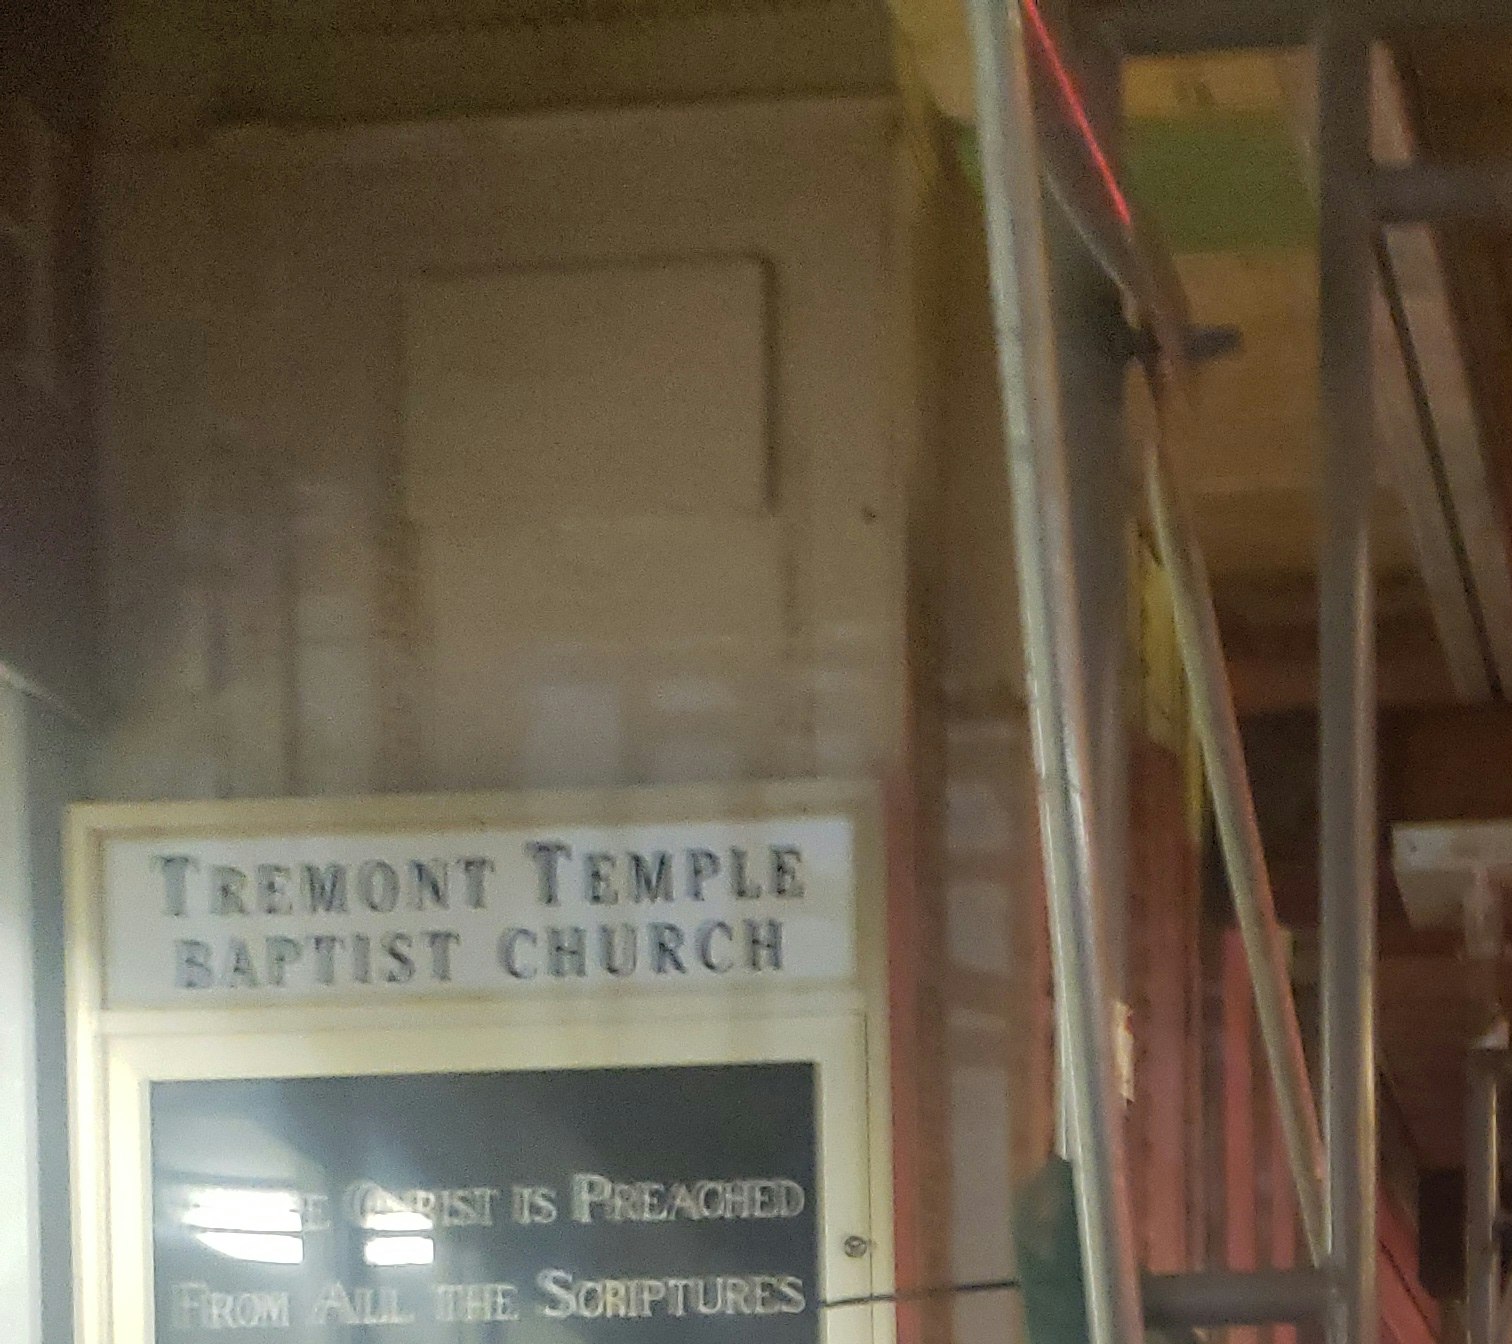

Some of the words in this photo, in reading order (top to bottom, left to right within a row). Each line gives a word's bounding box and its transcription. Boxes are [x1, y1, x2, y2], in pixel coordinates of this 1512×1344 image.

[152, 854, 496, 917] TREMONT
[525, 838, 804, 905] TEMPLE
[174, 930, 461, 990] BAPTIST
[499, 917, 783, 979] CHURCH
[512, 1184, 557, 1225] IS
[572, 1172, 805, 1223] PREACHED
[537, 1267, 806, 1320] SCRIPTURES
